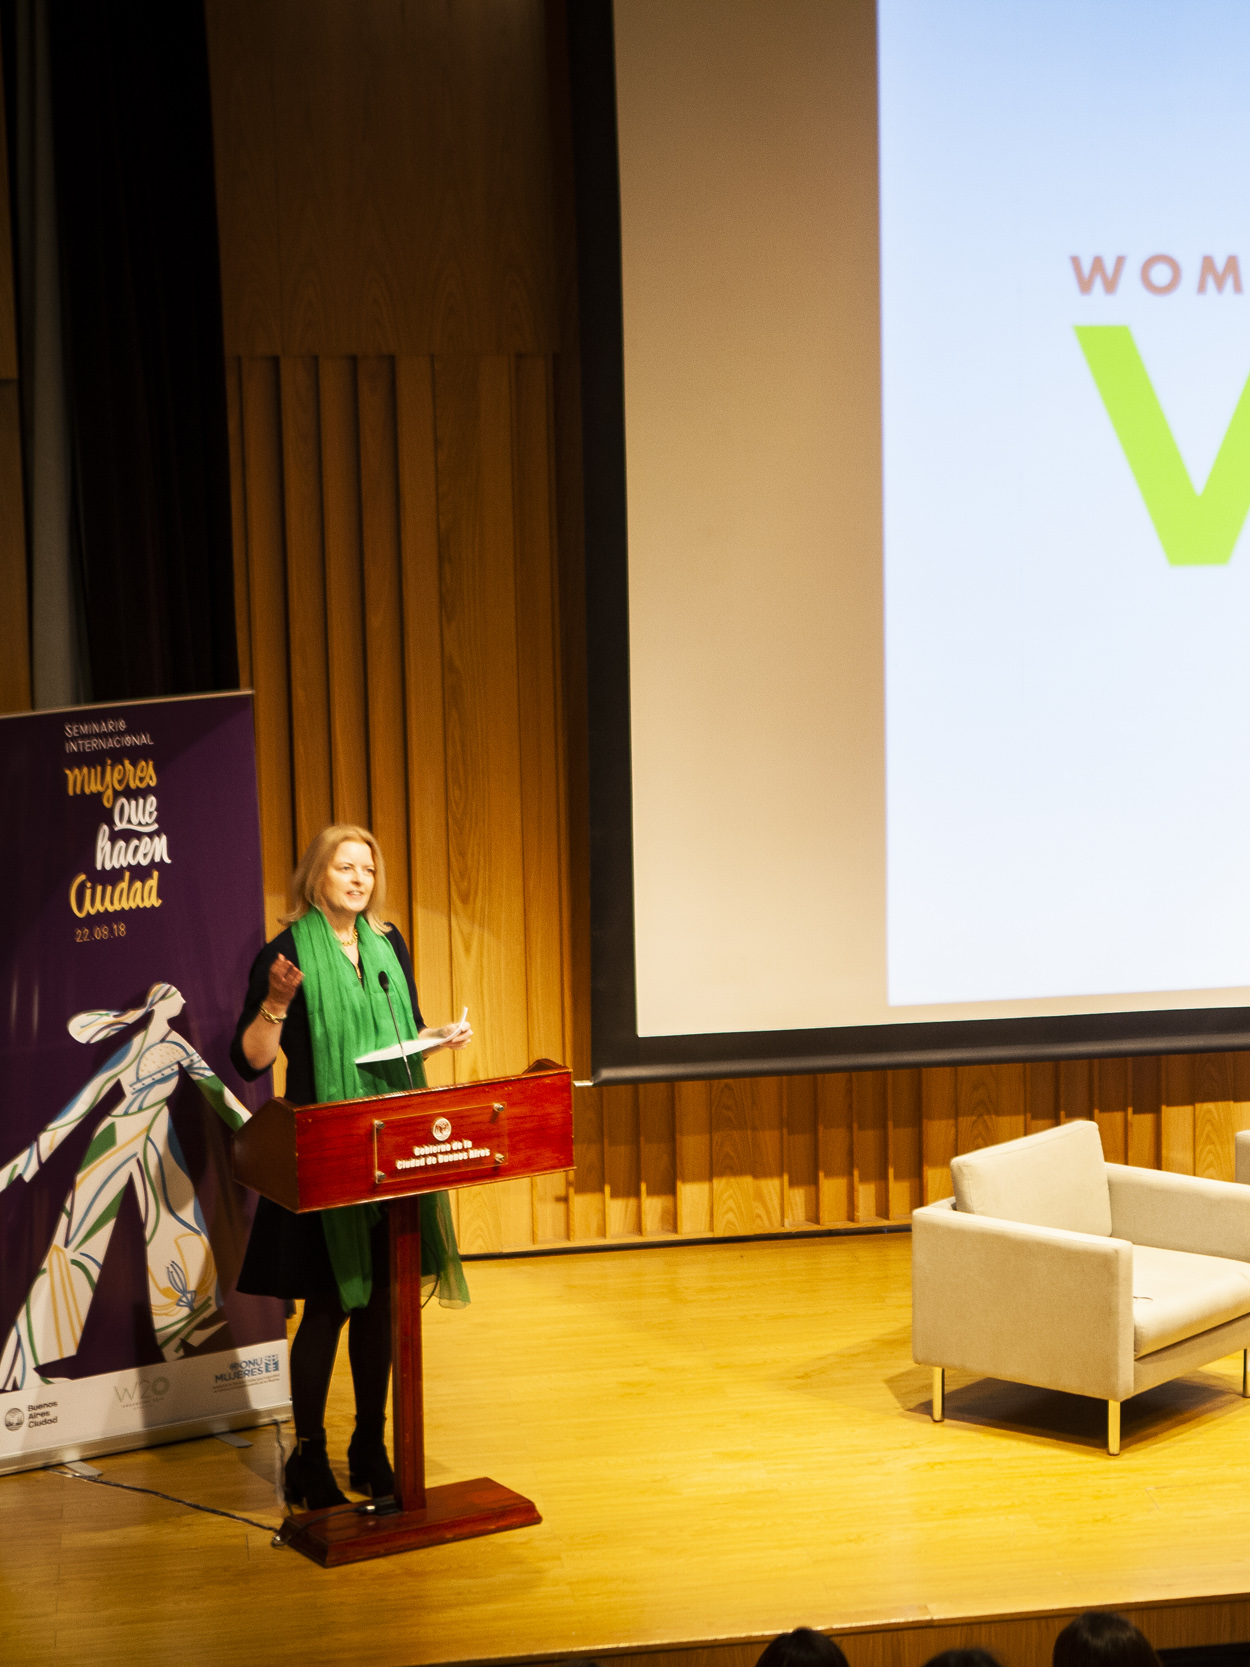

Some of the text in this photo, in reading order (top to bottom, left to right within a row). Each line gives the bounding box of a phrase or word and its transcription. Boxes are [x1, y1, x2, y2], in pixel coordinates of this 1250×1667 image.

[64, 718, 127, 738] SEMINARIO
[65, 733, 155, 753] INTERNACIONAL
[64, 757, 157, 808] mujeres
[95, 822, 172, 871] hacen
[70, 869, 163, 919] Ciudad
[74, 921, 127, 943] 22.08.18
[413, 1139, 472, 1156] Gobierno de la
[396, 1157, 425, 1169] Ciudad
[426, 1155, 437, 1165] de
[437, 1151, 468, 1163] Buenos
[240, 1357, 263, 1369] ONU
[215, 1366, 264, 1383] MUJERES
[114, 1376, 170, 1402] W20
[27, 1401, 58, 1411] Buenos
[28, 1416, 58, 1428] Ciudad
